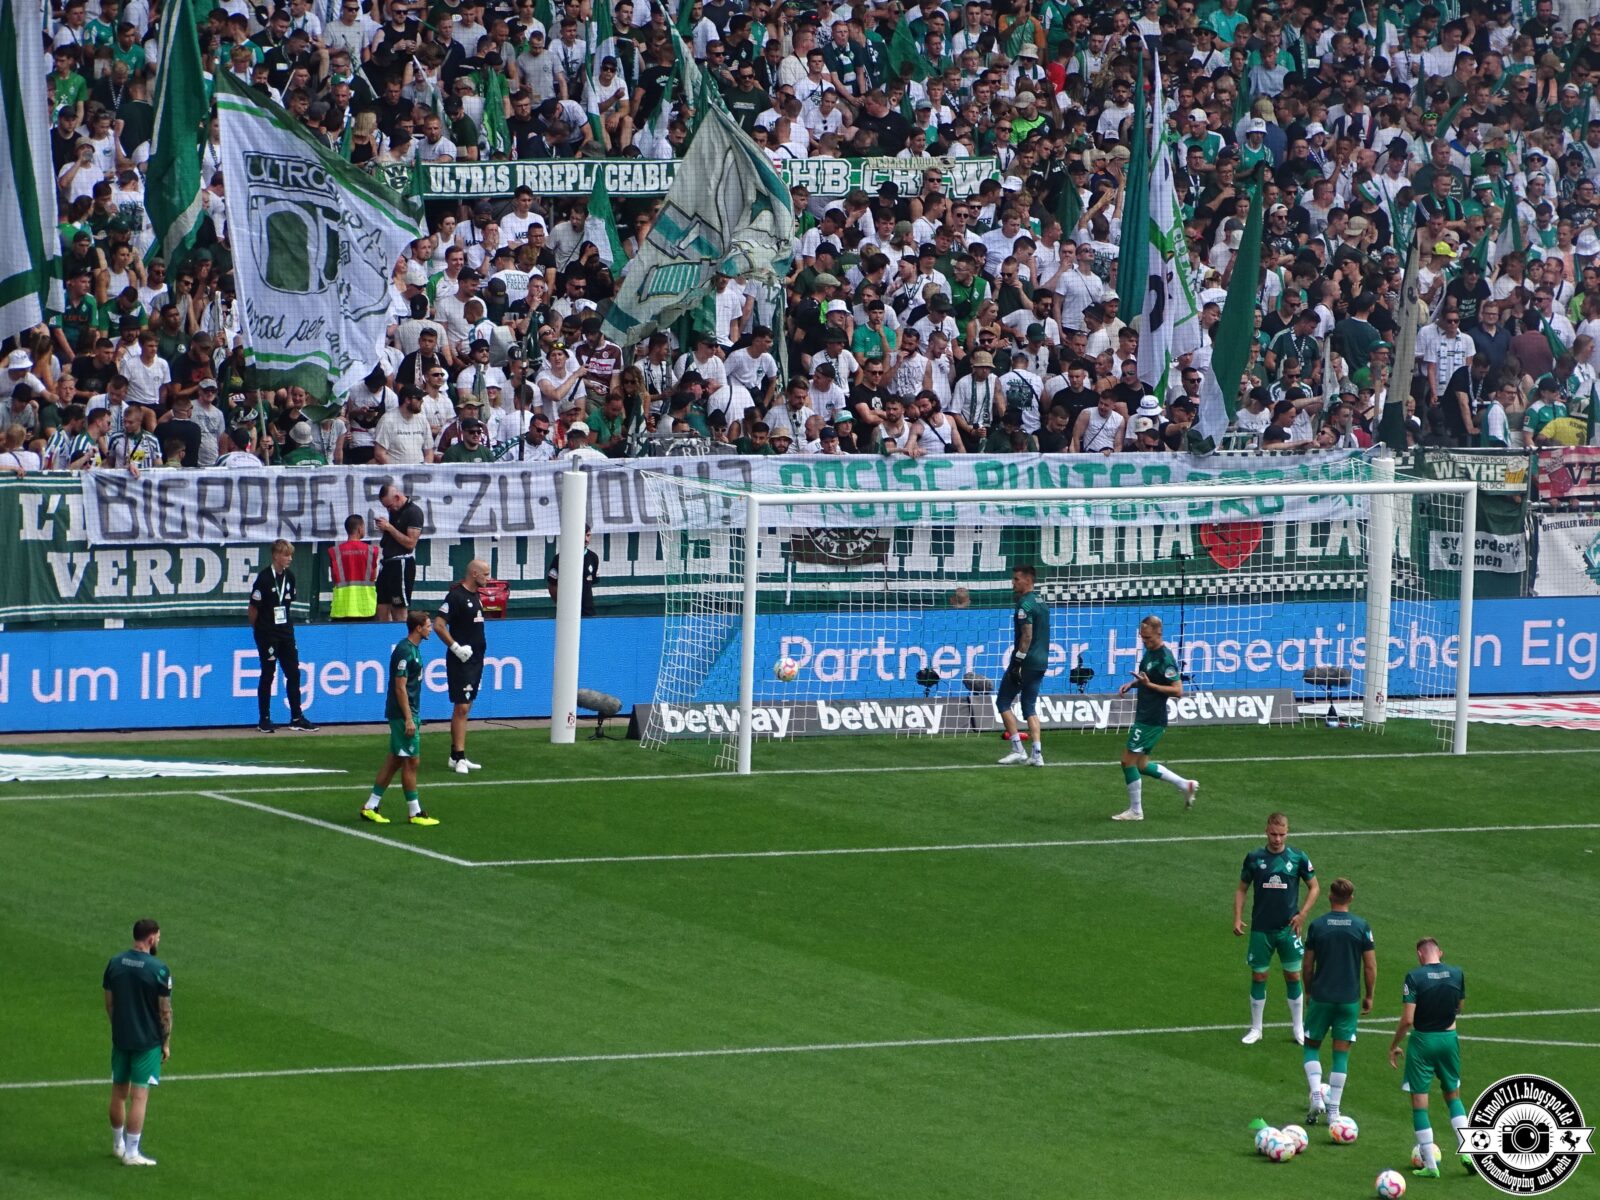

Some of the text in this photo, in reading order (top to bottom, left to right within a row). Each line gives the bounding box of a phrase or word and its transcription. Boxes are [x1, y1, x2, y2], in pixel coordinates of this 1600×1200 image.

[429, 162, 678, 193] ULTRAS IRREPLCEABL
[789, 159, 849, 197] HB
[1433, 461, 1507, 482] WEYHE
[1543, 519, 1577, 532] OFFIZIELLER
[1474, 537, 1514, 553] erder
[47, 547, 260, 598] VERDE
[32, 659, 118, 702] um
[141, 649, 212, 700] Ihr
[780, 635, 985, 683] Partner
[659, 702, 792, 738] betway
[816, 699, 944, 734] betway
[1132, 728, 1142, 742] 5
